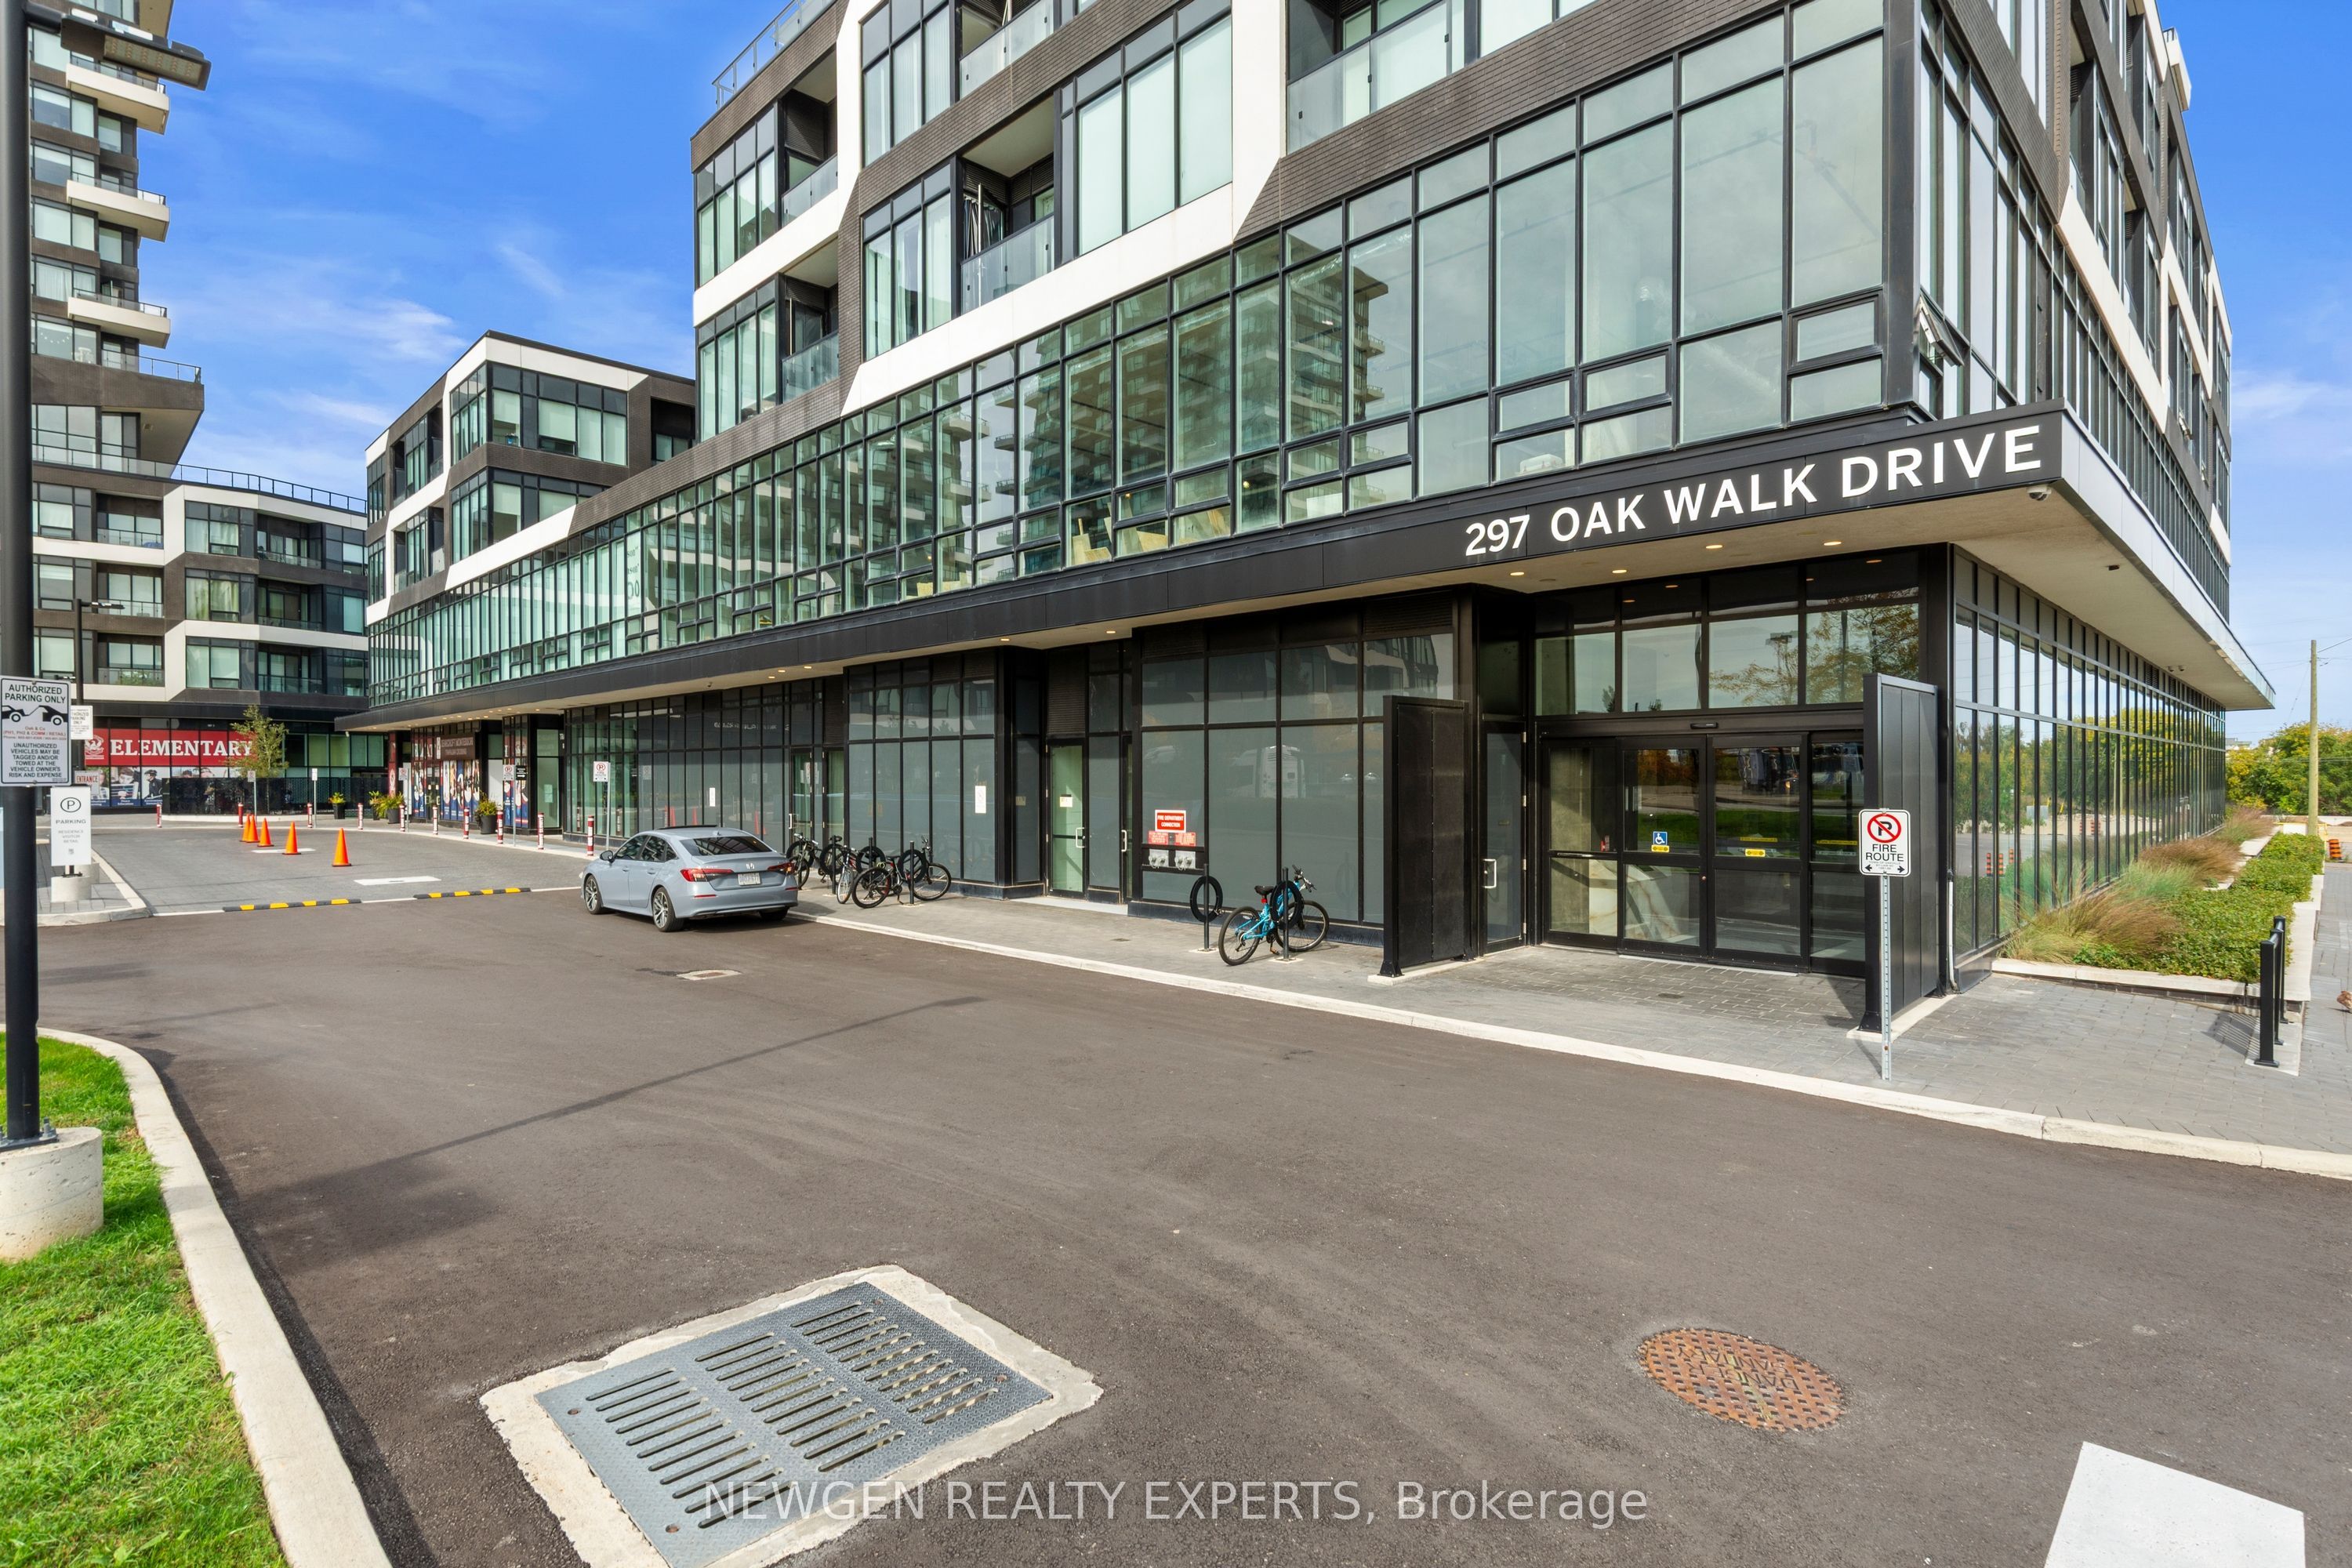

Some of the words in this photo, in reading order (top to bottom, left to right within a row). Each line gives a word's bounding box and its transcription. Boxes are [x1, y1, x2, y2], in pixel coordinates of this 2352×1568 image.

[1465, 514, 1530, 557] 297
[1550, 494, 1646, 543] OAK
[1663, 463, 1819, 526] WALK
[1841, 424, 2042, 499] DRIVE
[9, 684, 63, 695] AUTHORIZED
[5, 692, 42, 702] PARKING
[45, 695, 66, 703] ONLY
[111, 739, 253, 757] ELEMENTARY
[1872, 844, 1896, 852] FIRE
[1865, 852, 1904, 862] ROUTE
[1679, 1345, 1788, 1373] SANITARY
[1689, 1363, 1799, 1390] DANGER
